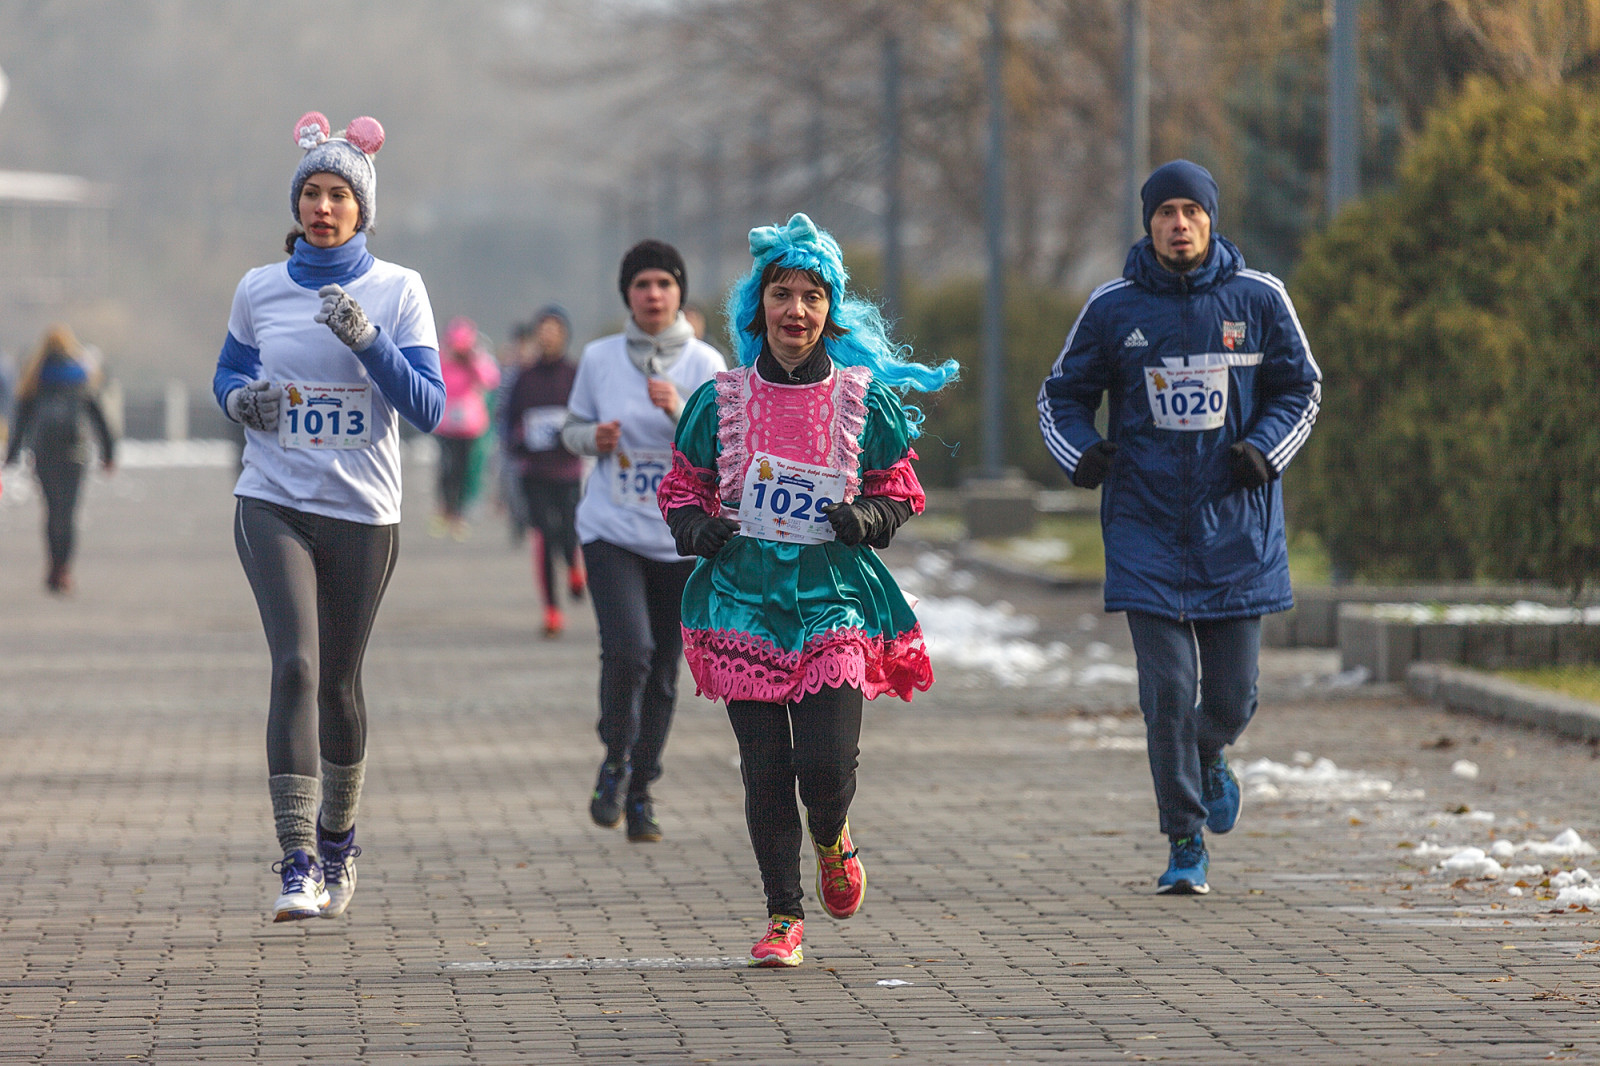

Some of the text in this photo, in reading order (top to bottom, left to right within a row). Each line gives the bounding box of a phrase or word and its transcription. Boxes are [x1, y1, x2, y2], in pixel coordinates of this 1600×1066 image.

[1124, 339, 1149, 348] adidas
[1155, 390, 1223, 416] 1020
[287, 409, 365, 435] 1013
[753, 483, 834, 523] 1029
